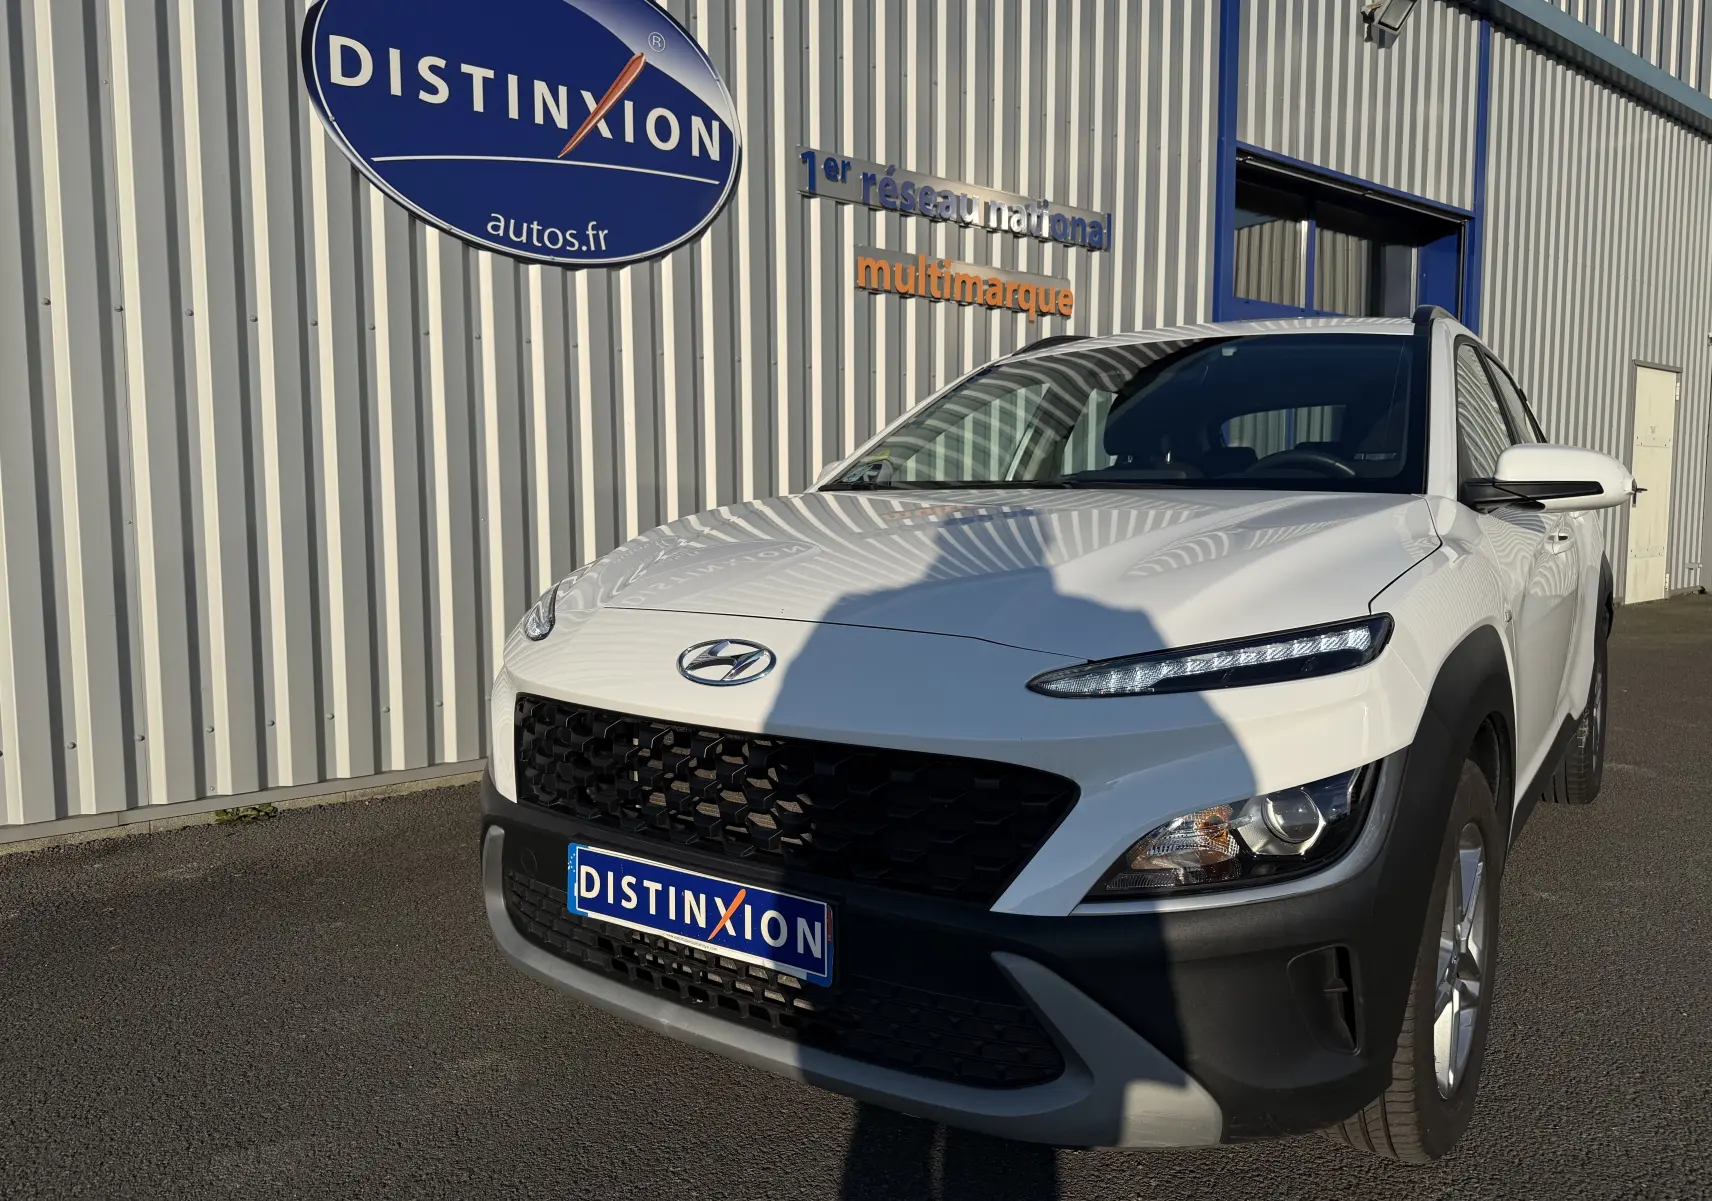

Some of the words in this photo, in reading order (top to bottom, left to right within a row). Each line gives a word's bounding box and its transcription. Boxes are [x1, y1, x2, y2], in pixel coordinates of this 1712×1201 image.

[329, 35, 720, 162] DISTINXION
[487, 213, 608, 251] autos.fr
[801, 151, 850, 195] 1er
[862, 165, 979, 226] réseau
[989, 199, 1111, 251] national
[857, 254, 1074, 323] multimarque
[580, 865, 822, 958] DISTINXION
